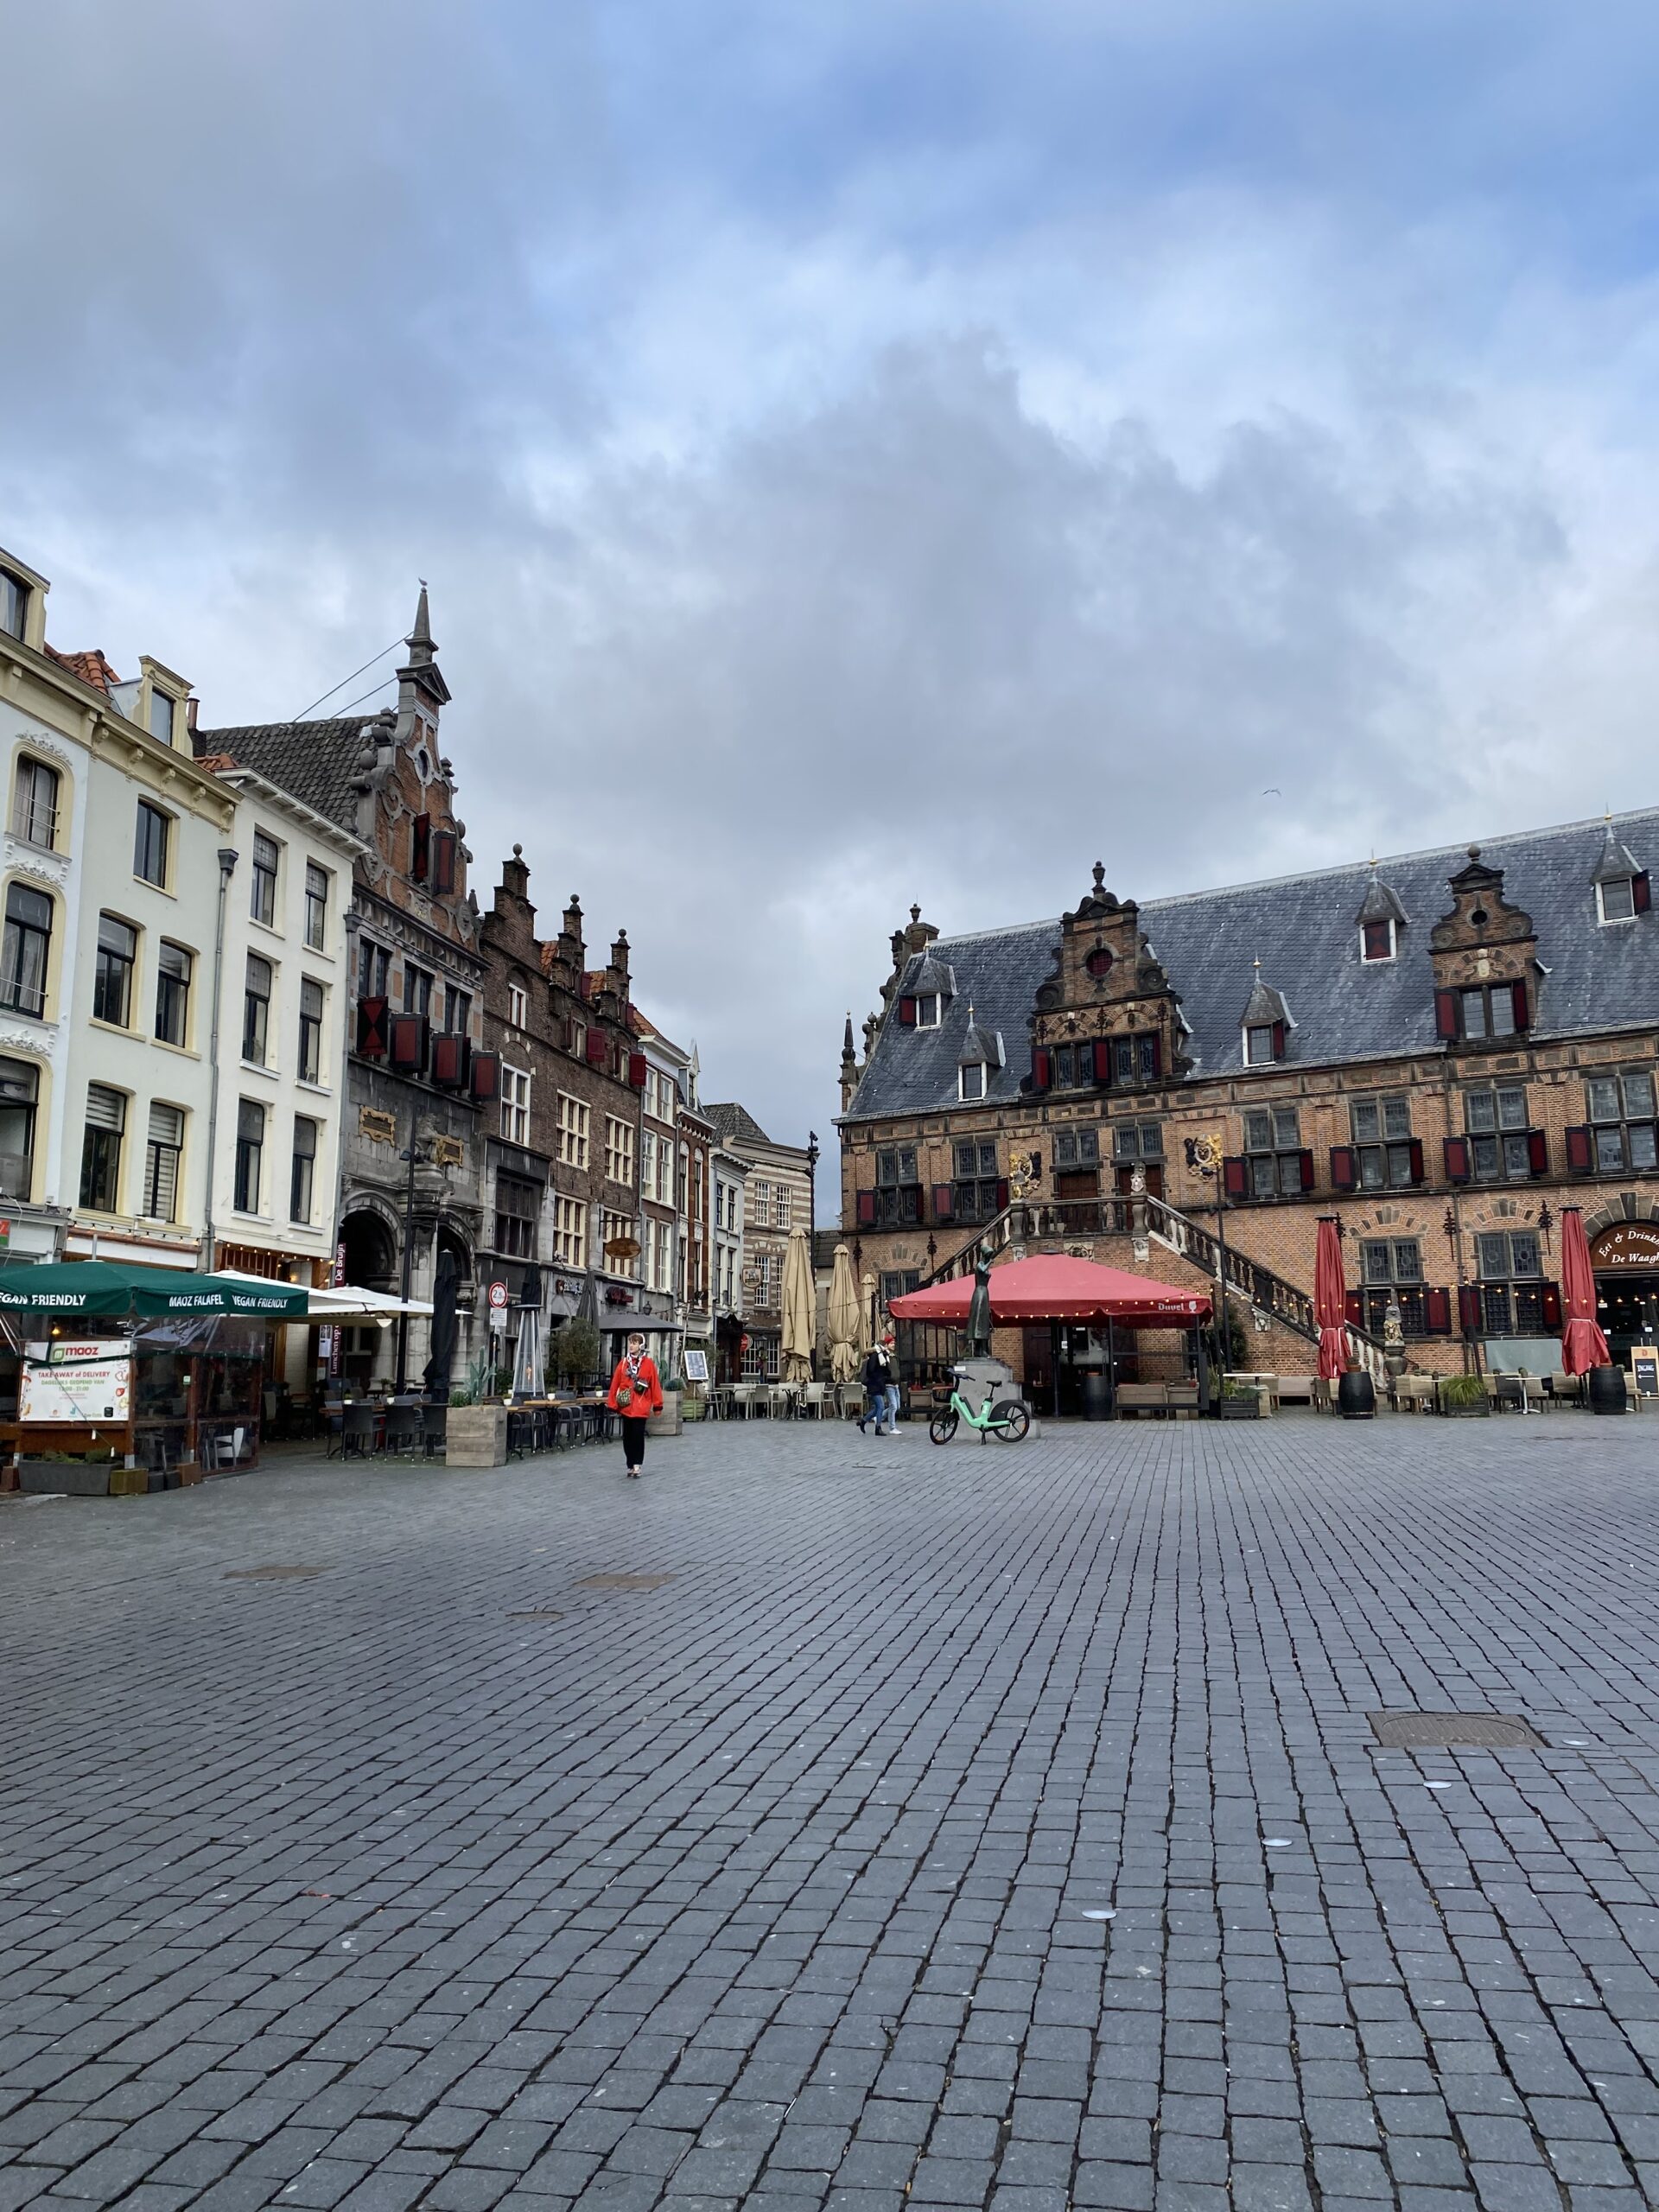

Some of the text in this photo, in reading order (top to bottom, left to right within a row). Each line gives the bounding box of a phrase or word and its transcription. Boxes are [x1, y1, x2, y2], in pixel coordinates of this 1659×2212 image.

[1615, 1233, 1624, 1243] &
[334, 1243, 346, 1281] De Bruijn
[1611, 1254, 1625, 1263] De
[31, 1294, 86, 1306] FRIENDLY
[168, 1294, 225, 1307] MAOZ FALAFEL
[232, 1294, 289, 1308] VEGAN FRIENDLY
[1158, 1302, 1184, 1311] Duvel
[65, 1346, 99, 1356] maoz
[331, 1329, 341, 1375] Lunchen op
